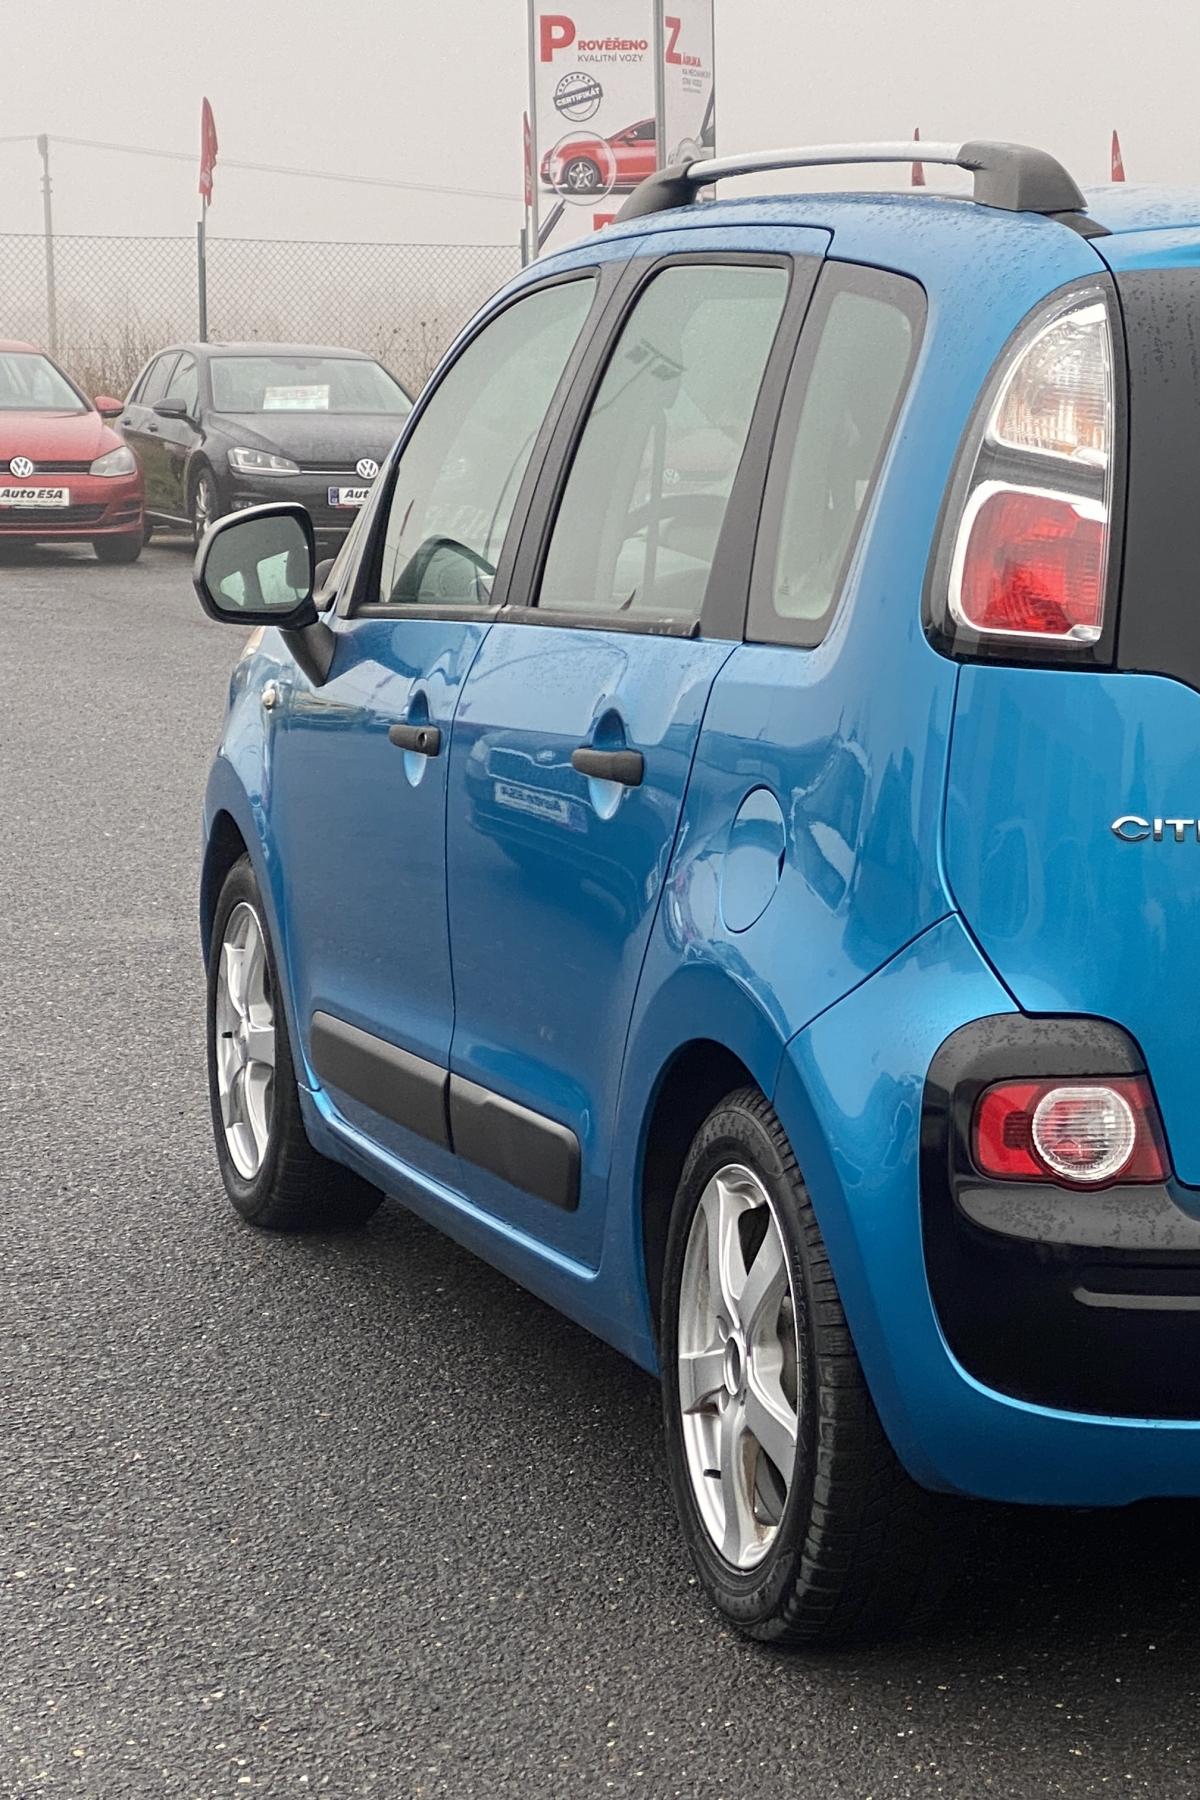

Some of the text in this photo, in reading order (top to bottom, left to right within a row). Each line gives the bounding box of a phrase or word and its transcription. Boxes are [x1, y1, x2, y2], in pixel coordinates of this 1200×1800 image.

[577, 53, 644, 62] KVALITNÍ VOZY
[556, 86, 601, 107] CERTIFIKÁT
[1, 489, 63, 499] Auto ESA
[344, 489, 370, 499] Aut
